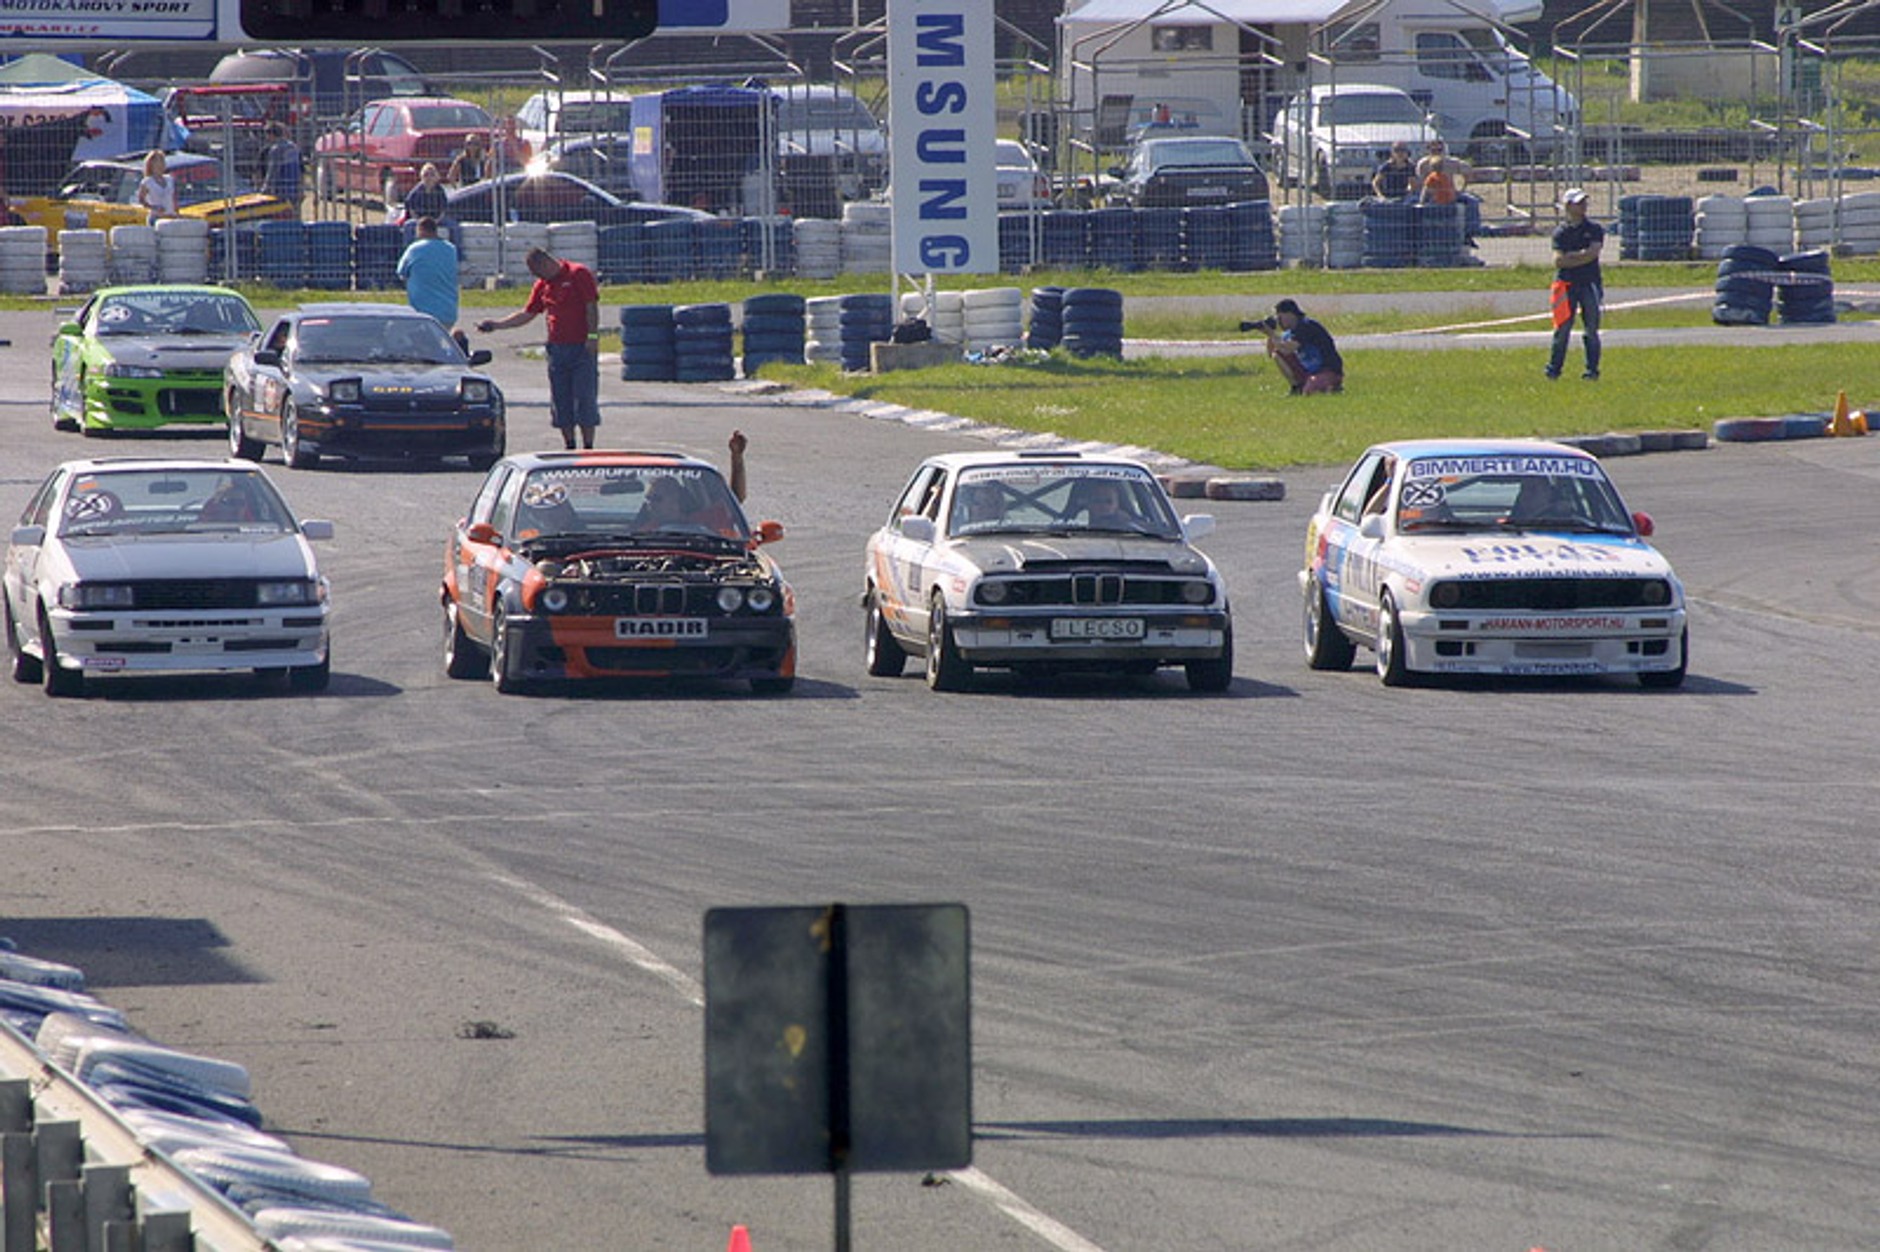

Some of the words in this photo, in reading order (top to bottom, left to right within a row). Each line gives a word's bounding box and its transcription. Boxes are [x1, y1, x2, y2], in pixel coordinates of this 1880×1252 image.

[131, 2, 190, 13] SPORT
[916, 14, 970, 269] MSUNG
[1411, 457, 1595, 477] BIMMERTEAM.HU
[619, 621, 704, 636] RADIR
[1068, 620, 1140, 636] LECSO
